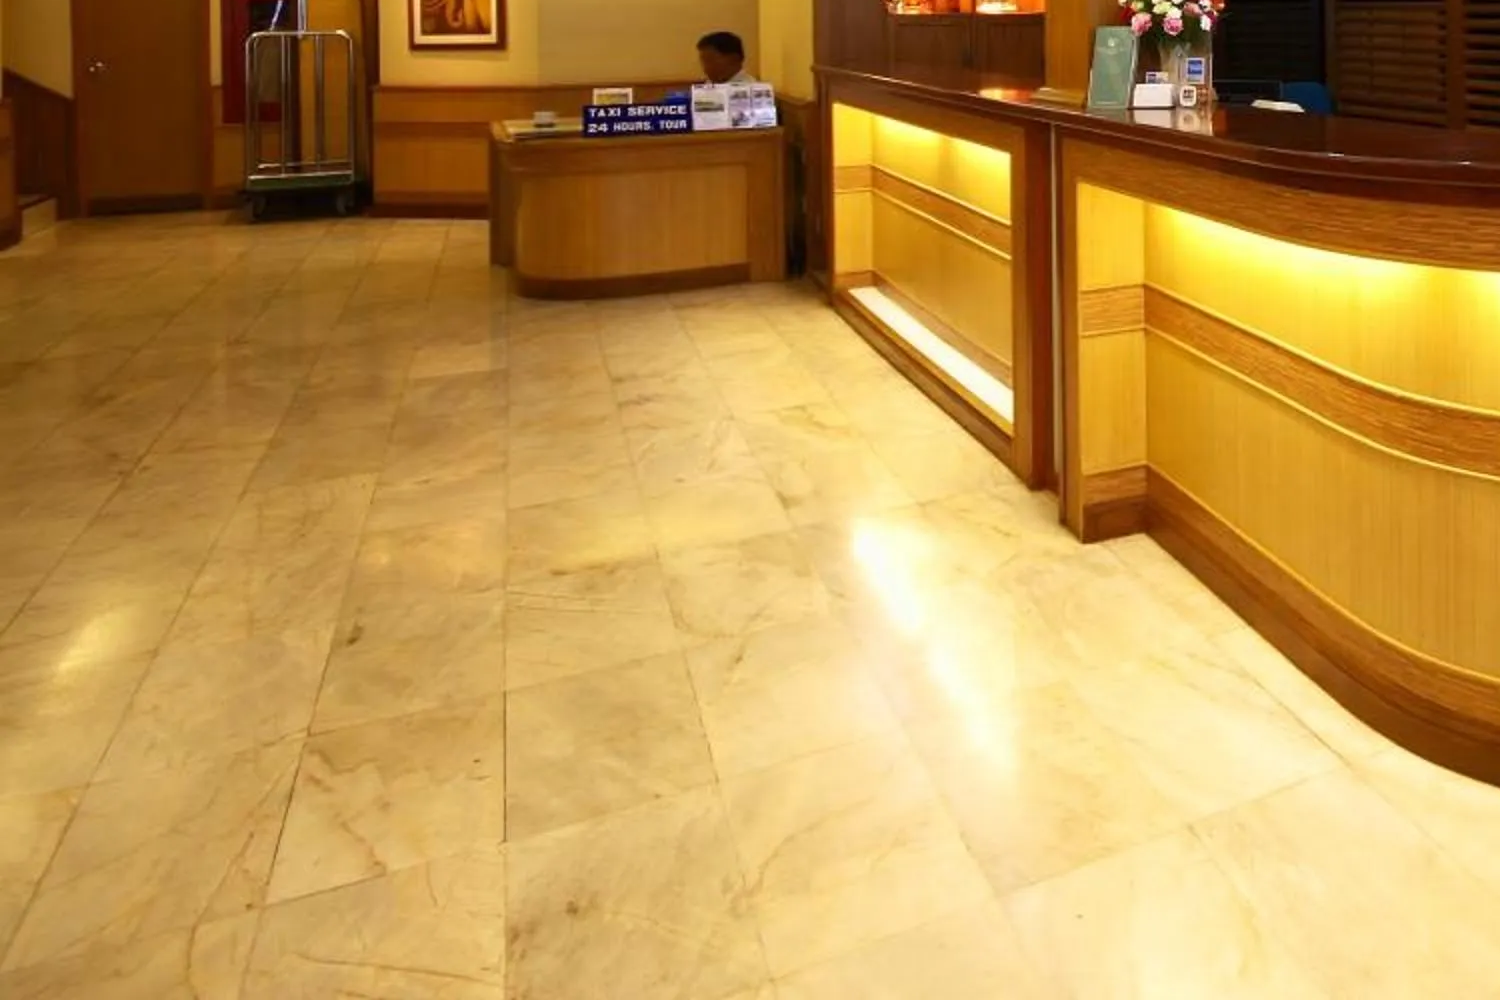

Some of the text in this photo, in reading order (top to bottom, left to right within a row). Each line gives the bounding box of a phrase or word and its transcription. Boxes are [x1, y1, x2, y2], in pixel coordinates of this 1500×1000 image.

[588, 105, 688, 118] TAXI SERVICE
[587, 123, 609, 134] 24
[659, 119, 688, 130] TOUR
